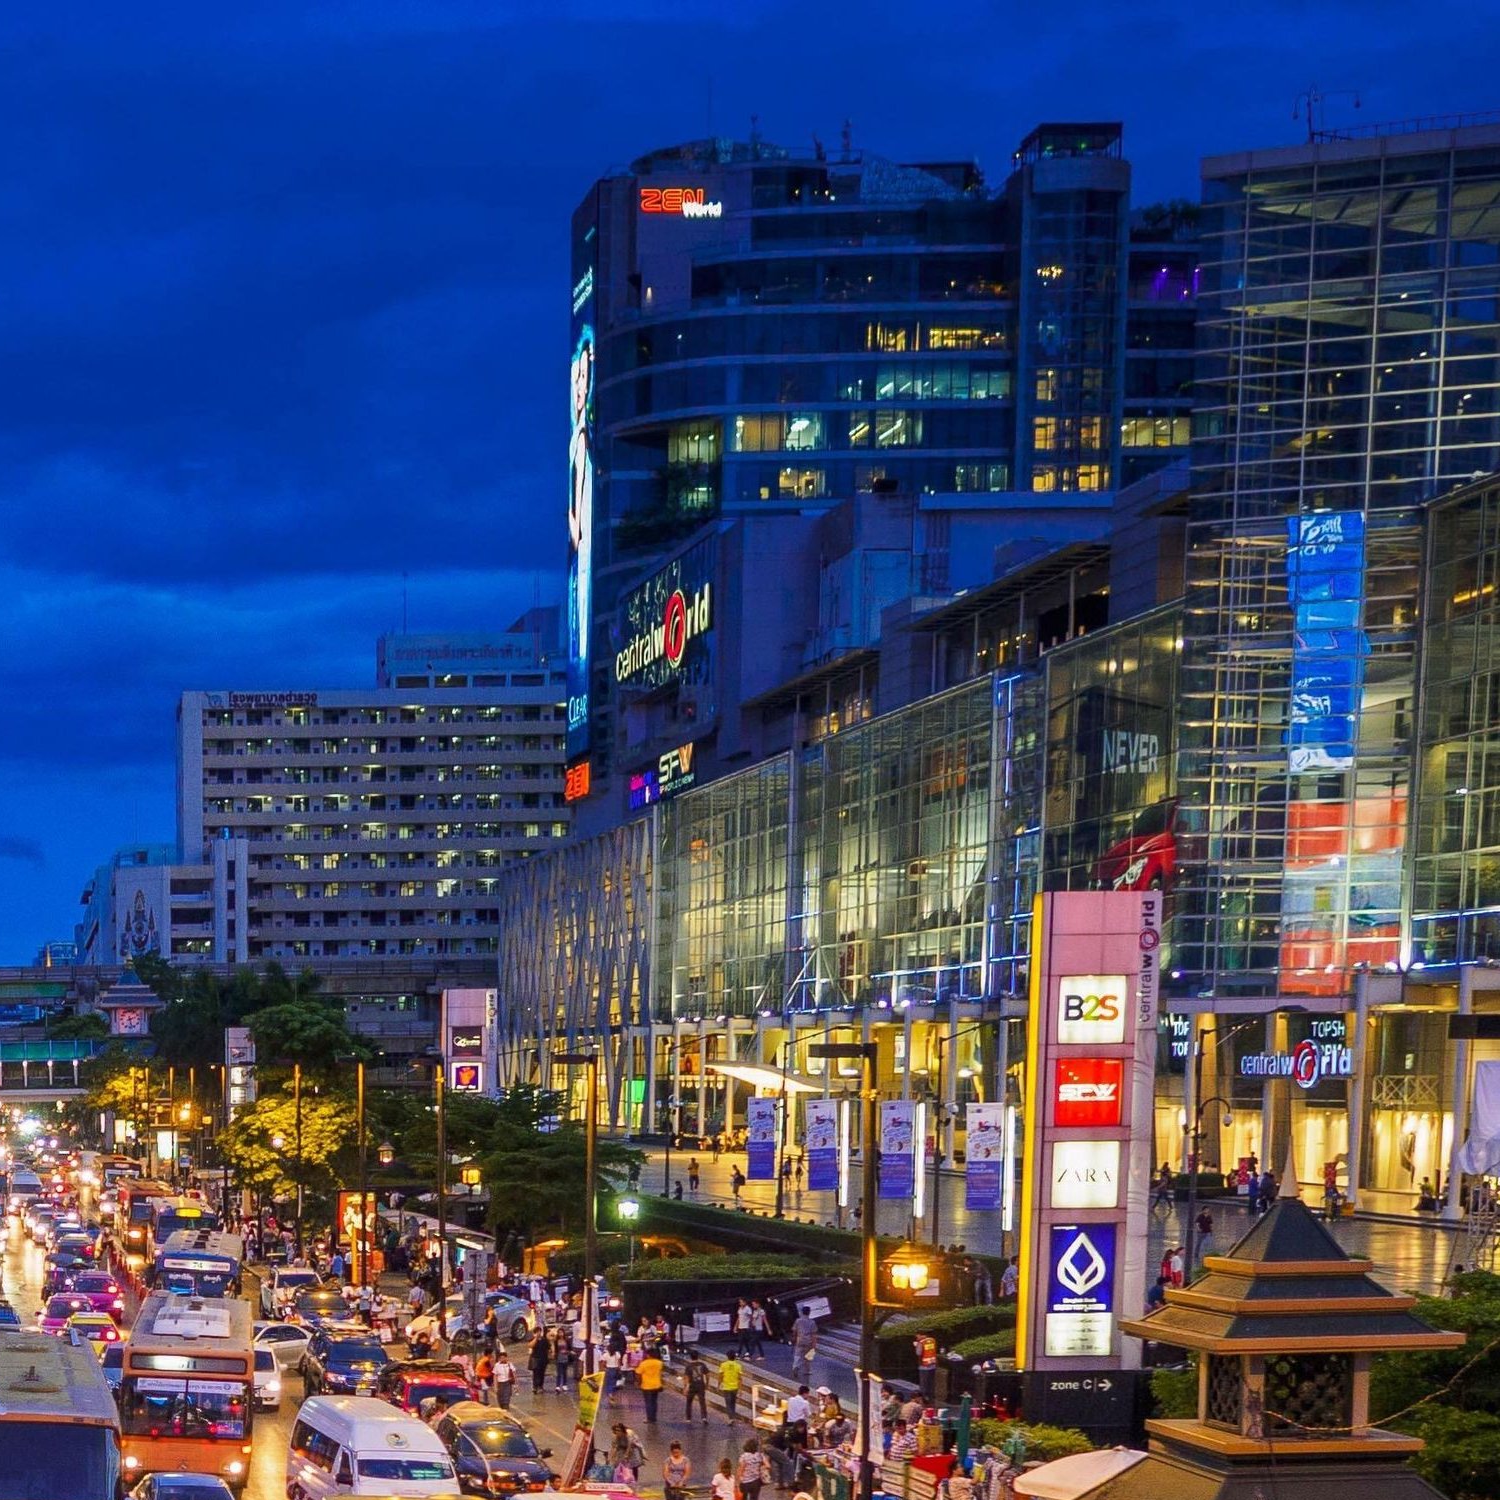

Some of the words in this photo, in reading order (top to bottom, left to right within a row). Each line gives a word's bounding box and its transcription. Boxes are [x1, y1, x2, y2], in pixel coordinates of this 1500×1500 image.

[640, 188, 704, 213] ZEN
[568, 693, 588, 724] CLEAR
[1102, 729, 1158, 774] NEVER
[1140, 899, 1159, 1023] centralworld
[1064, 995, 1119, 1021] B2S
[1241, 1039, 1352, 1088] centralworld
[1058, 1168, 1111, 1182] ZARA
[1051, 1381, 1080, 1391] zone
[1083, 1379, 1093, 1390] C
